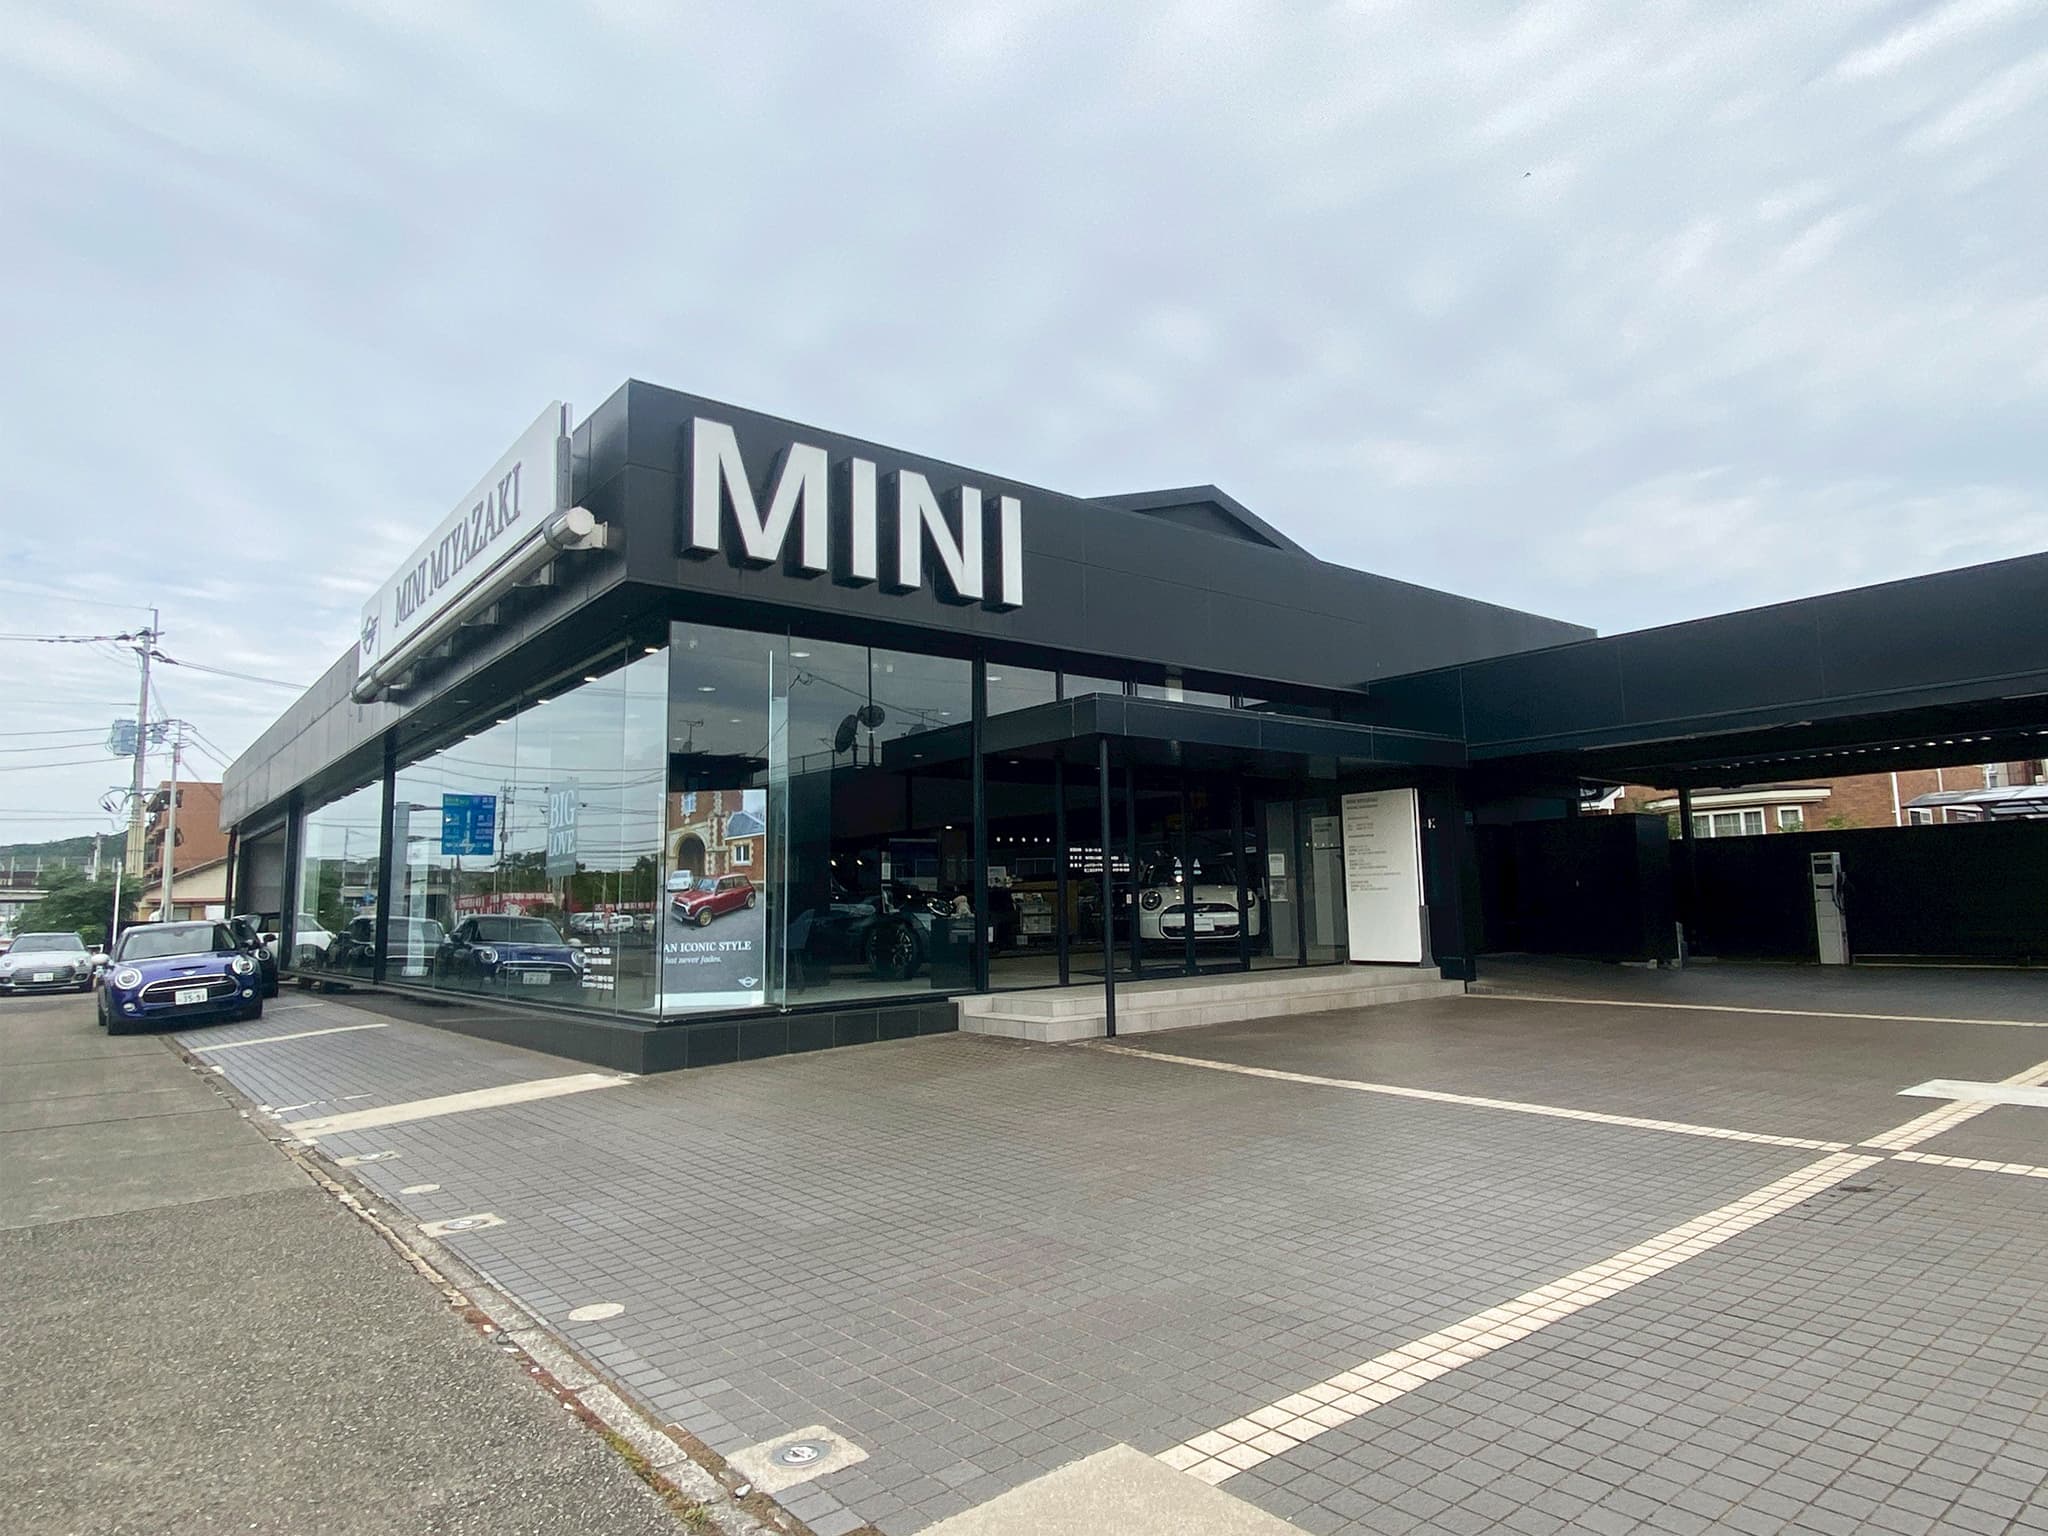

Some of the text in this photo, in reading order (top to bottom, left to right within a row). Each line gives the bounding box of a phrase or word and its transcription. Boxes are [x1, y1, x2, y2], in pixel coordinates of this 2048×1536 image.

[395, 460, 521, 629] MINI MIYAZAKI
[690, 416, 1024, 608] MINI
[549, 790, 575, 830] BIG
[664, 941, 752, 953] AN ICONIC STYLE
